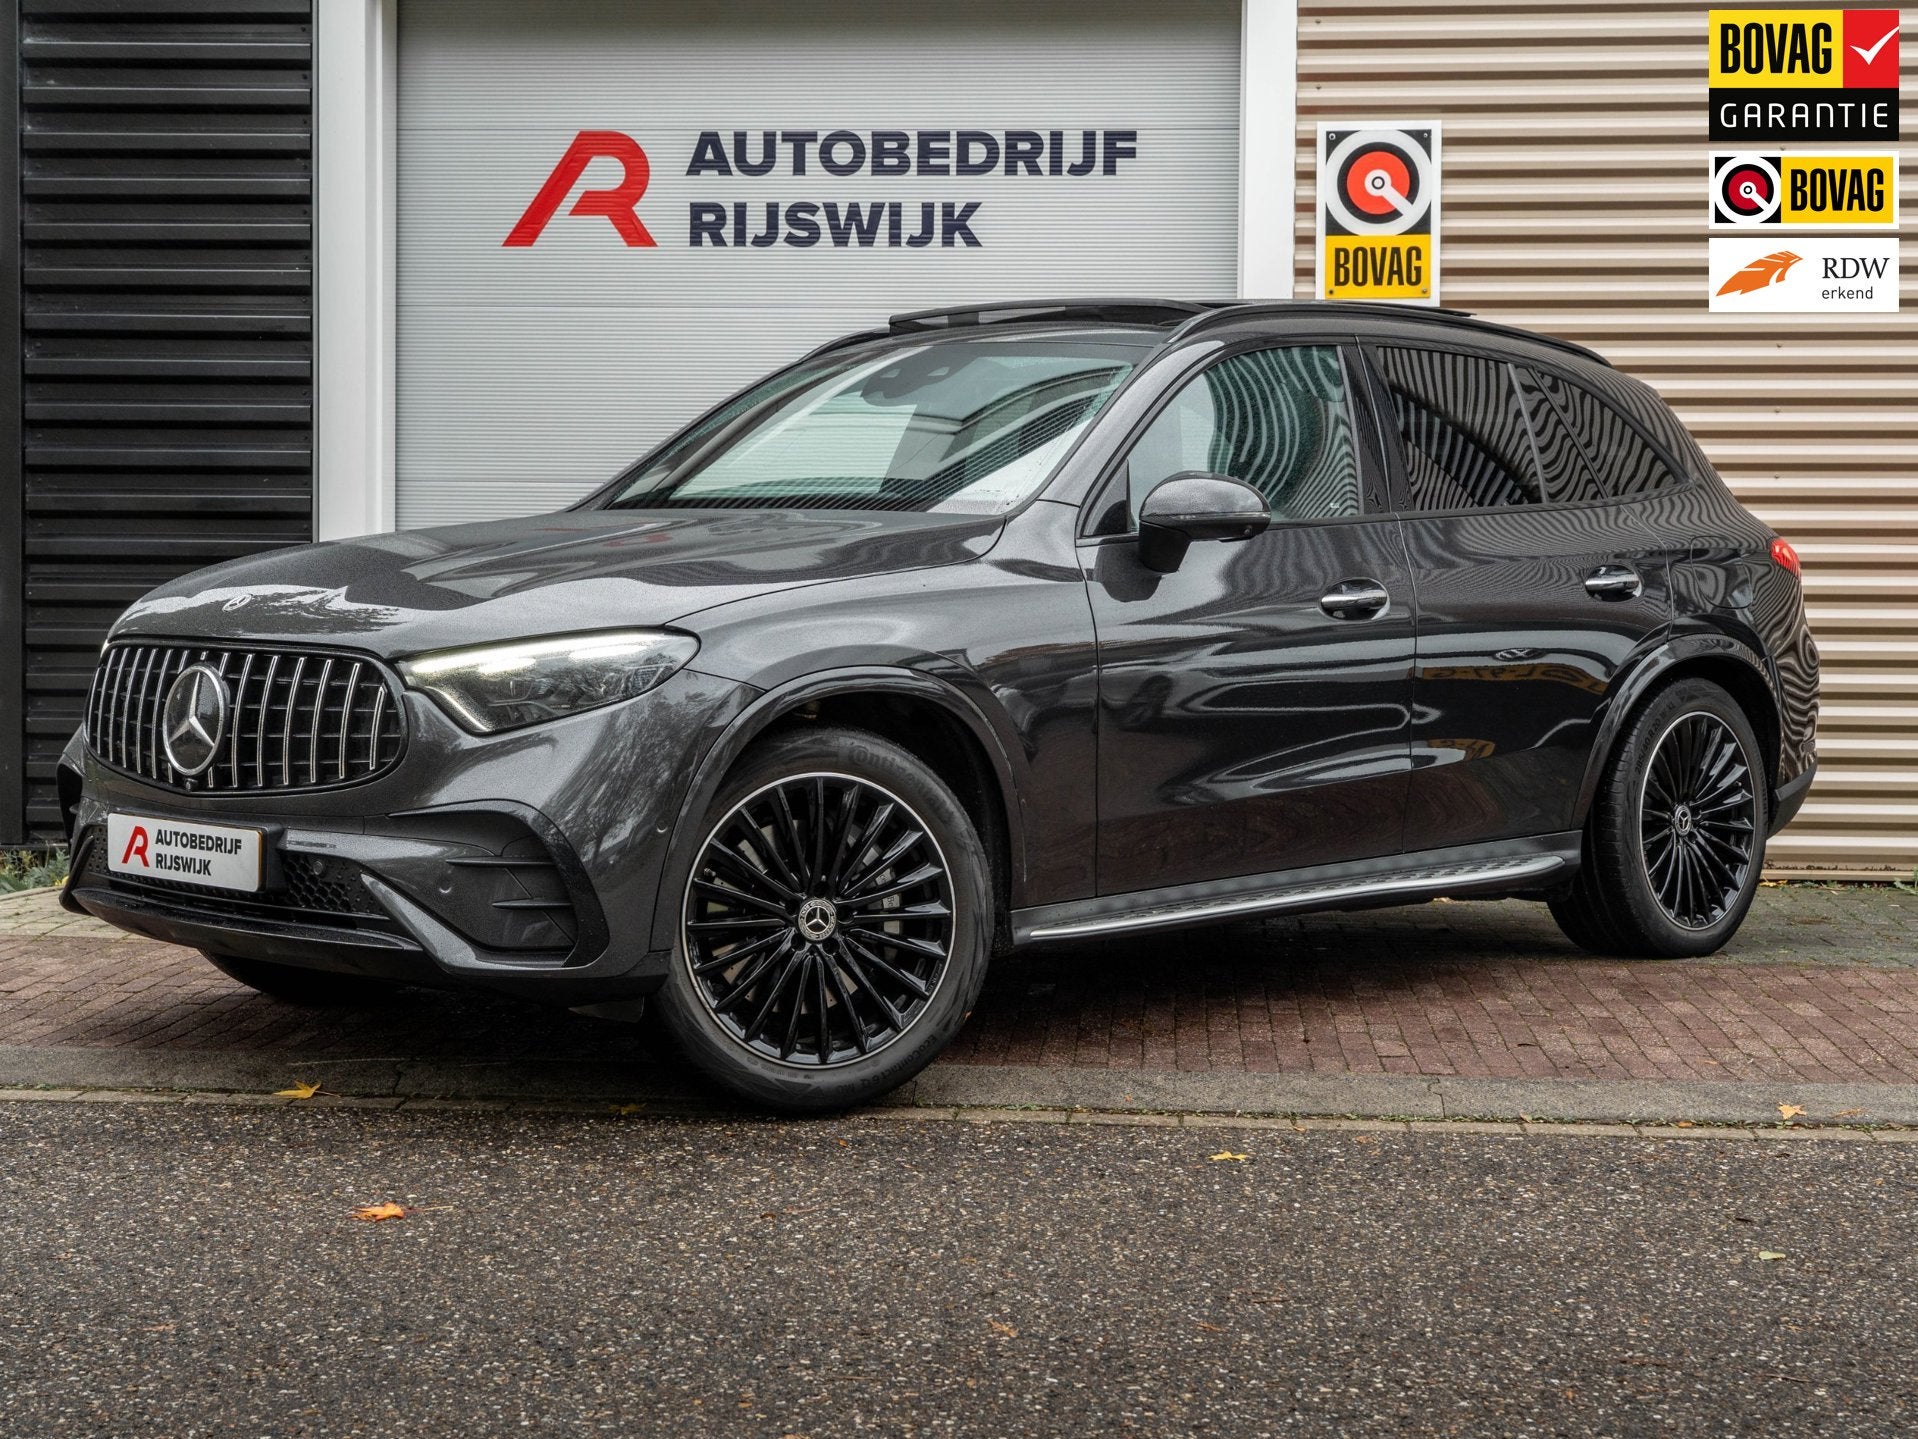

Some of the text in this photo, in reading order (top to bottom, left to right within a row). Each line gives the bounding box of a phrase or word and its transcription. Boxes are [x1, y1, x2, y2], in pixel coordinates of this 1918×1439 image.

[685, 130, 1138, 176] AUTOBEDRIJF
[689, 202, 984, 248] RIJSWIJK
[1334, 246, 1422, 287] BOVAG
[155, 829, 242, 855] AUTOBEDRIJF
[155, 853, 212, 876] RIJSWIJK
